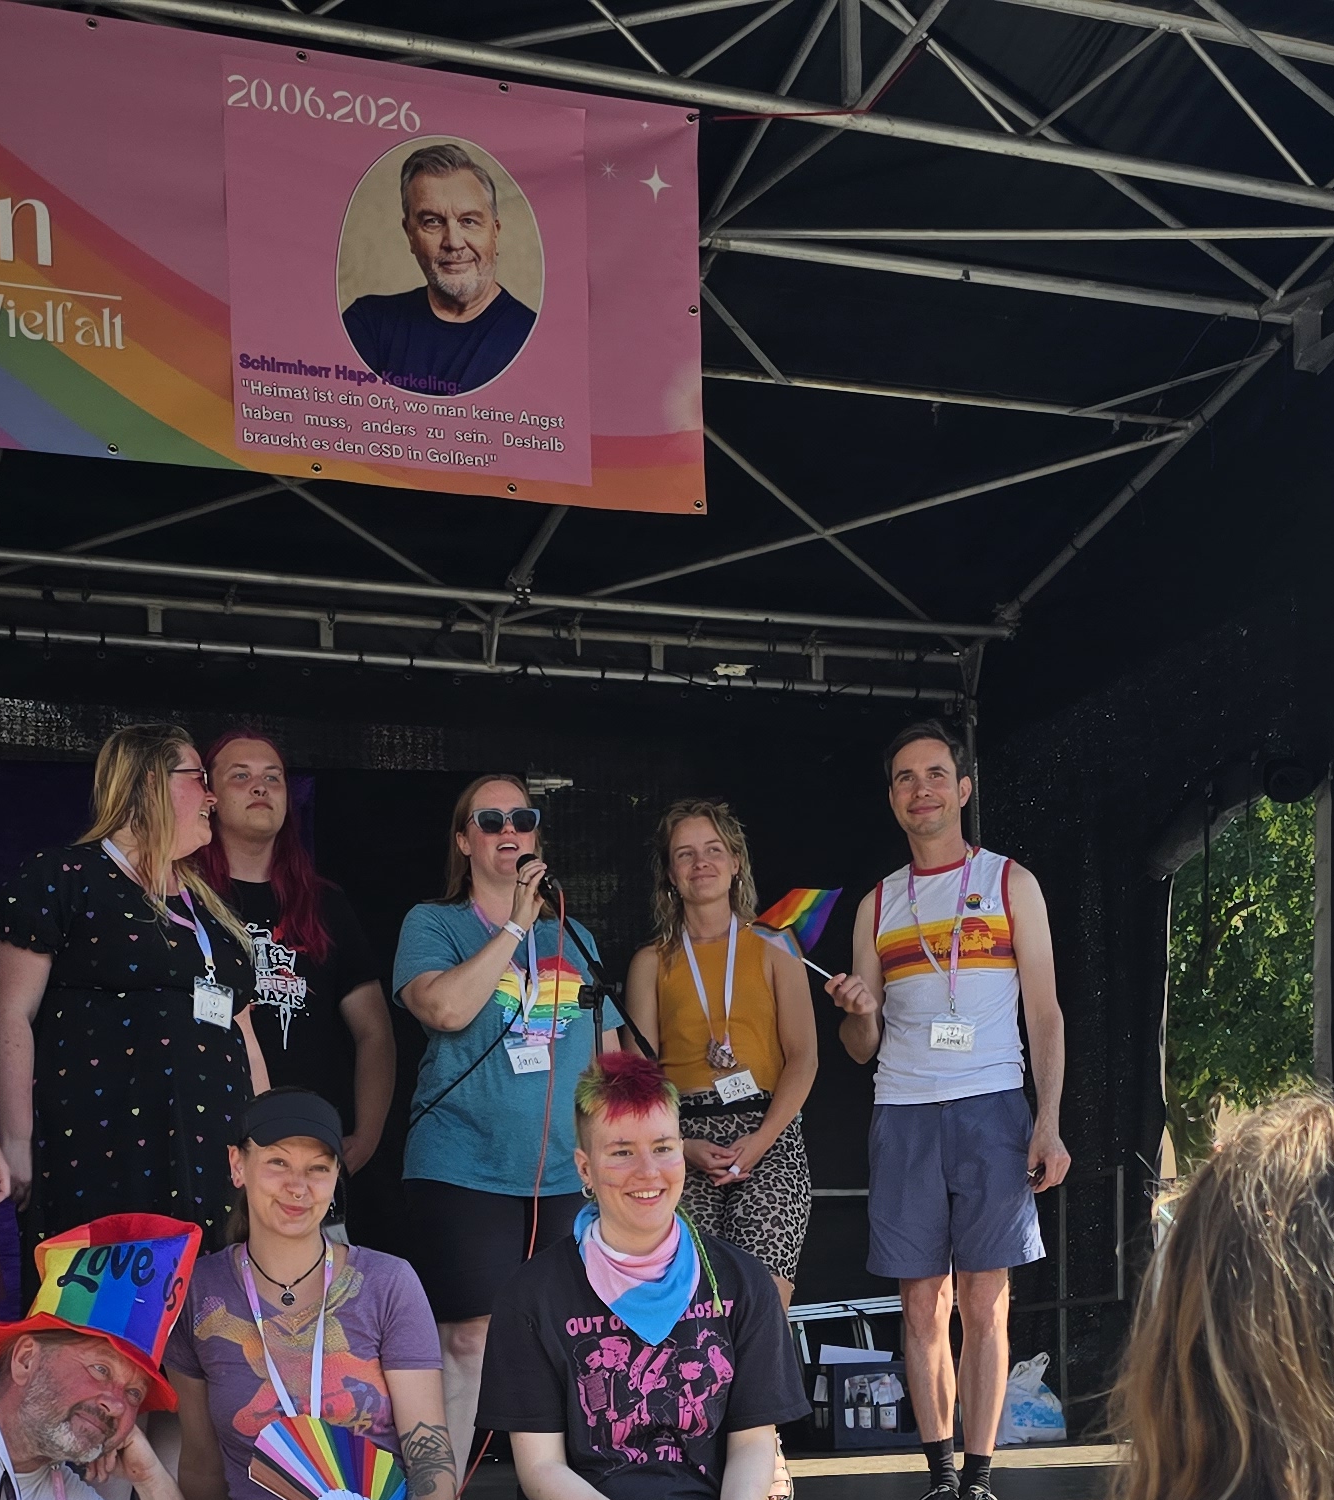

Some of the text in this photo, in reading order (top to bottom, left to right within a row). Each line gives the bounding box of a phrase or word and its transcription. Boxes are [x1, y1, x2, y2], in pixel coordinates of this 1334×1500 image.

[227, 74, 421, 132] 20.06.2026
[239, 353, 462, 395] Schirmherr Hape Kerkeling:
[242, 379, 565, 430] "Heimat ist ein Ort, wo man keine Angst
[241, 404, 565, 453] haben muss, anders zu sein. Deshalb
[242, 429, 307, 449] braucht
[311, 437, 330, 450] es
[334, 439, 364, 455] den
[368, 442, 404, 459] CSD
[407, 446, 423, 460] in
[517, 1055, 542, 1070] Jana
[57, 1244, 183, 1312] Love is
[566, 1316, 605, 1337] OUT
[679, 1299, 734, 1322] LOST
[656, 1446, 683, 1463] THE
